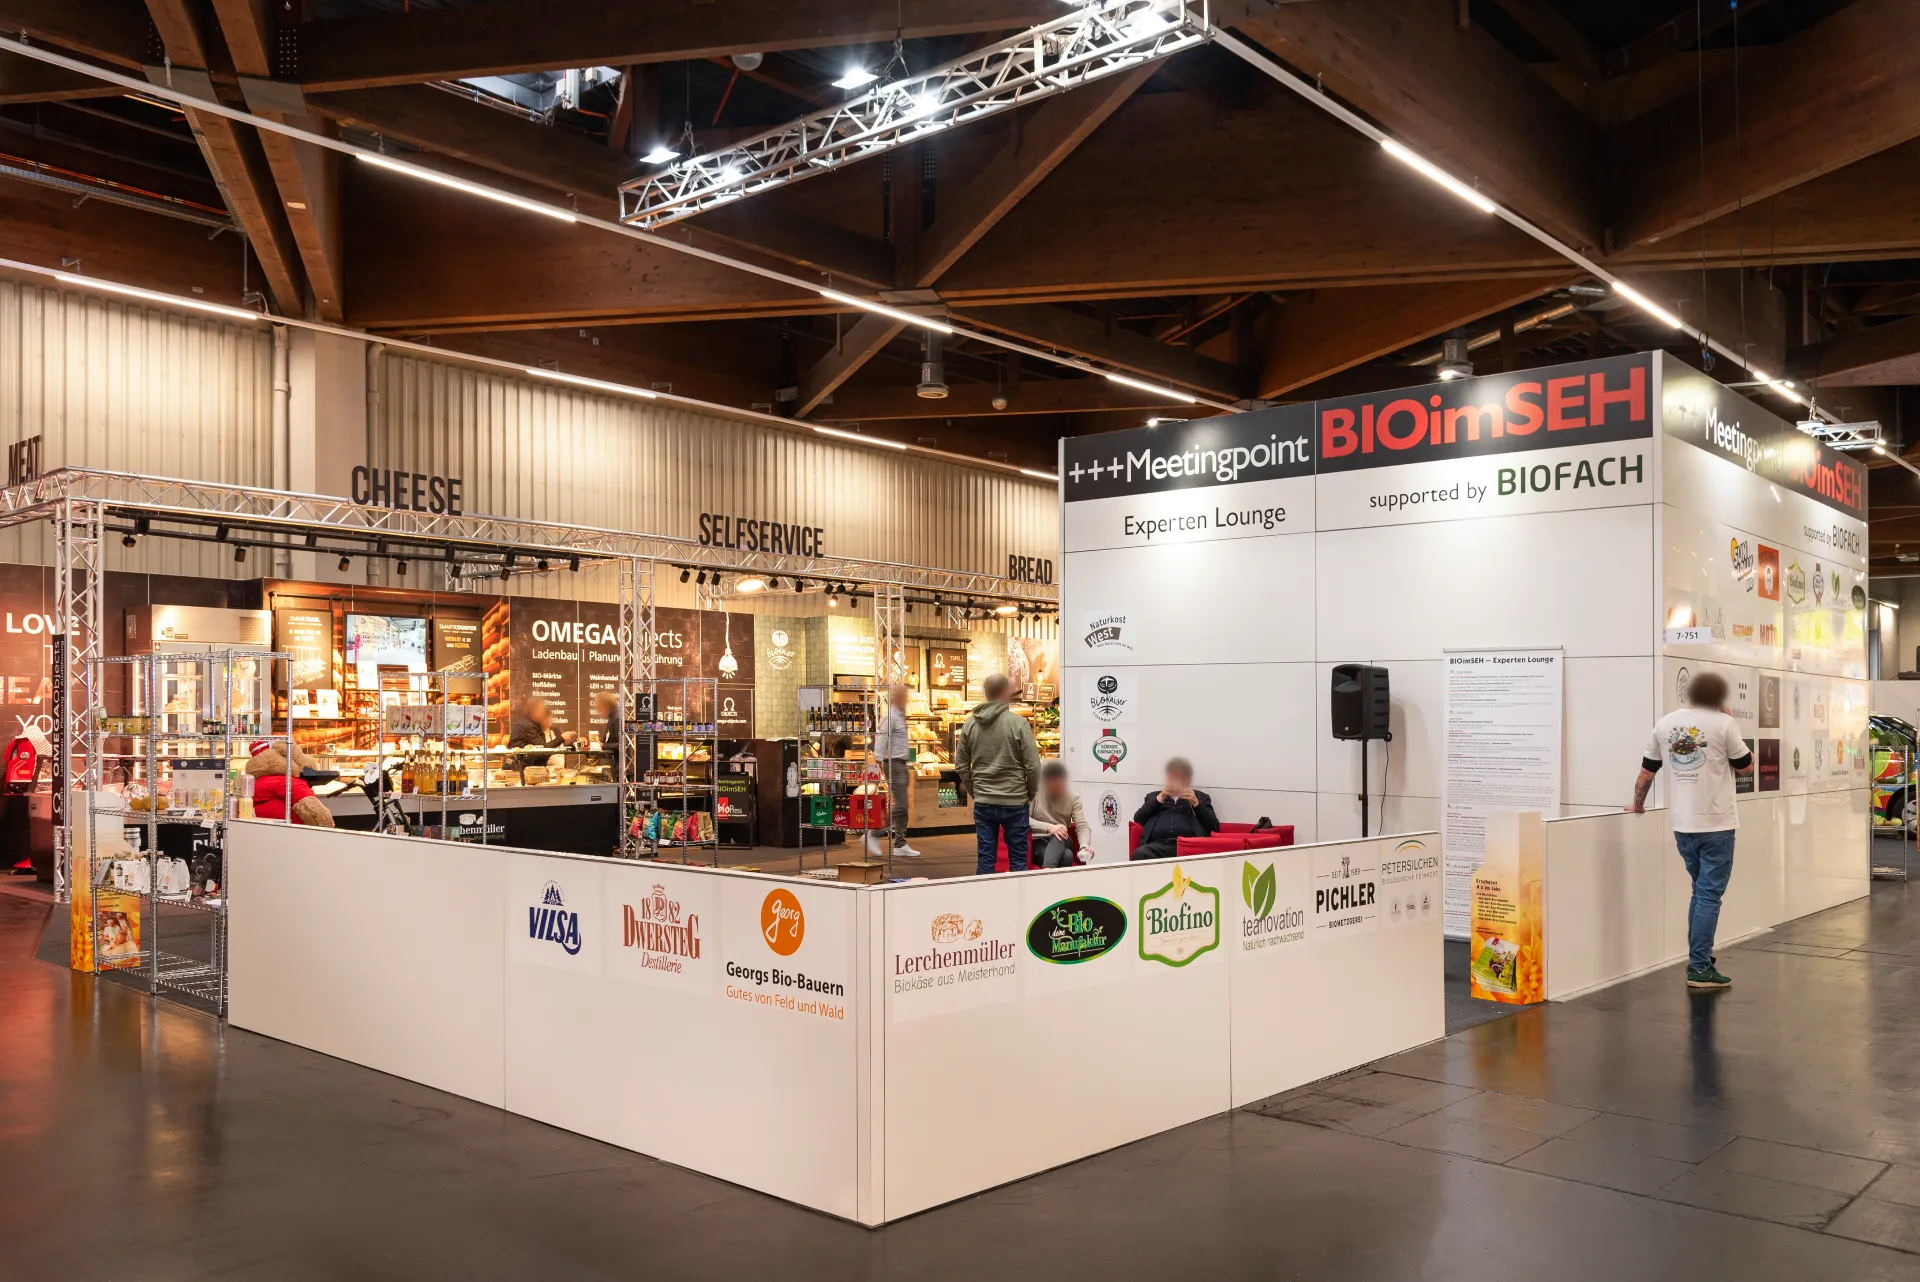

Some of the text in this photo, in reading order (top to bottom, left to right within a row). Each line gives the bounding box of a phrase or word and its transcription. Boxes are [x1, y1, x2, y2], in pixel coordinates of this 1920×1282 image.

[1321, 366, 1646, 460] BIOimSEH
[351, 465, 463, 516] CHEESE
[1369, 453, 1644, 511] supported by BIOFACH
[699, 512, 825, 558] SELFSERVICE
[1124, 503, 1287, 540] Experten Lounge
[1008, 553, 1053, 586] BREAD
[1087, 626, 1114, 646] West
[1089, 615, 1127, 631] Naturkost
[1676, 632, 1698, 640] 7-751
[532, 649, 579, 661] Ladenbau
[1449, 657, 1484, 665] BIOimSEH
[1493, 656, 1526, 665] Experten
[1527, 656, 1554, 664] Lounge
[532, 672, 562, 680] BIO-Märkte
[1331, 870, 1341, 879] SEIT
[1381, 856, 1439, 875] PETERSILCHEN
[641, 897, 681, 924] 18 82
[1316, 882, 1375, 914] PICHLER
[529, 906, 581, 954] VILSA
[622, 904, 701, 960] DWERSTEG
[1067, 911, 1094, 935] Bio
[1145, 902, 1213, 935] Biofino
[1243, 907, 1304, 938] teanovation
[1328, 915, 1363, 929] BIOMETZGEREI
[641, 951, 683, 974] Destillerie
[894, 939, 1016, 976] Lerchenmüller
[726, 961, 844, 997] Georgs Bio-Bauern
[894, 961, 1016, 993] Biokäse aus Meisterhand
[726, 984, 844, 1020] Gutes von Feld und Wald
